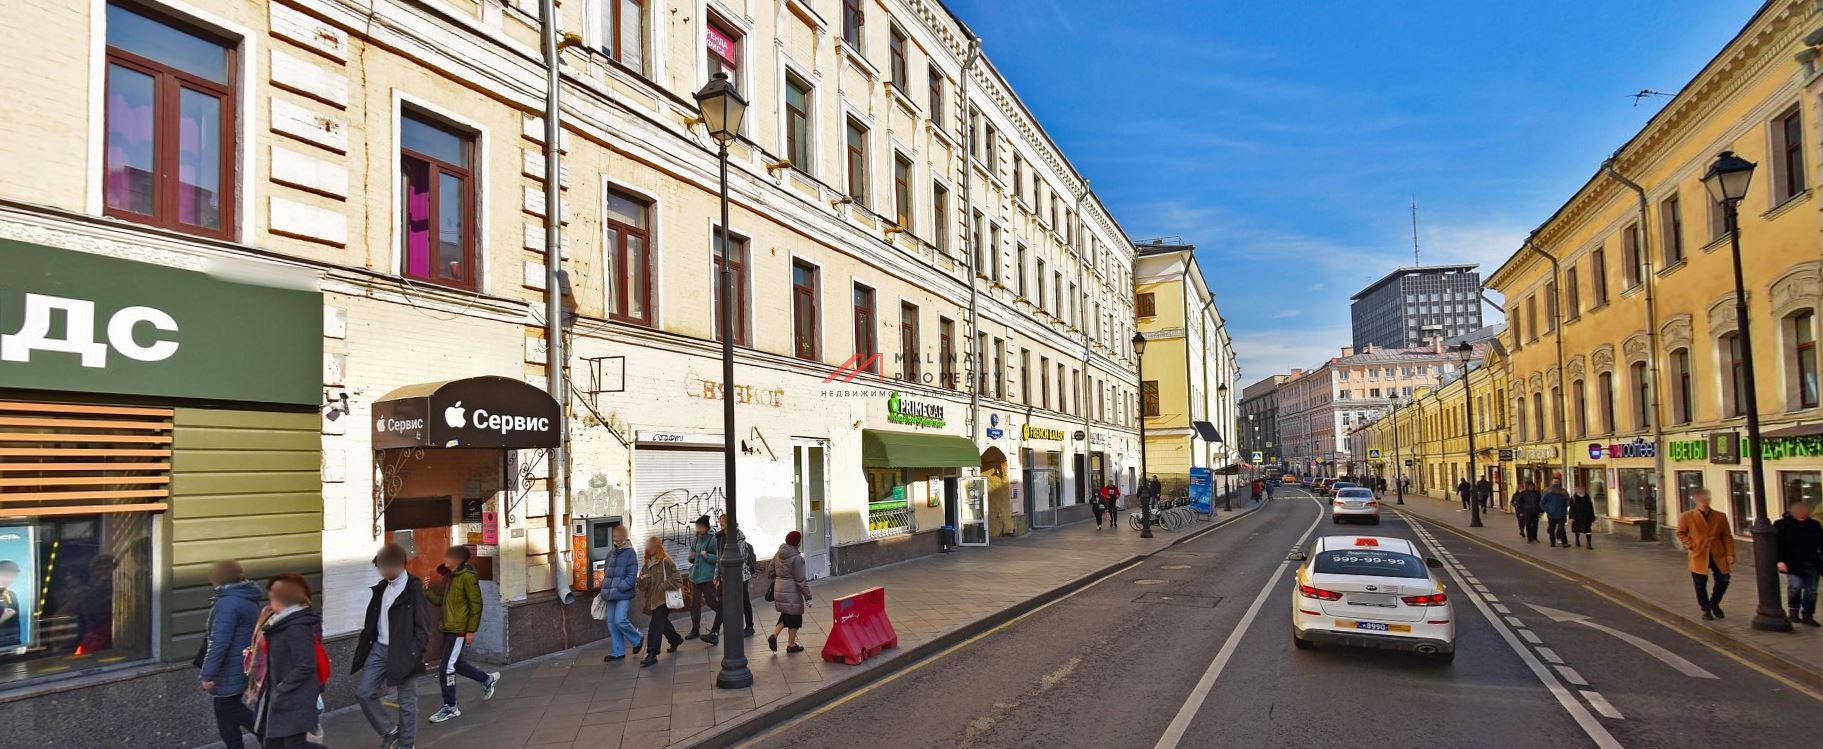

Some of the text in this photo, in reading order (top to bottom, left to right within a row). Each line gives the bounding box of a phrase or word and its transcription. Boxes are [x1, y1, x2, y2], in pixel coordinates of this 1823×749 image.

[387, 417, 424, 434] Сервис
[472, 408, 550, 435] Сервис
[1669, 439, 1708, 462] ЦВЕТЫ
[1332, 556, 1405, 565] 999-99-99
